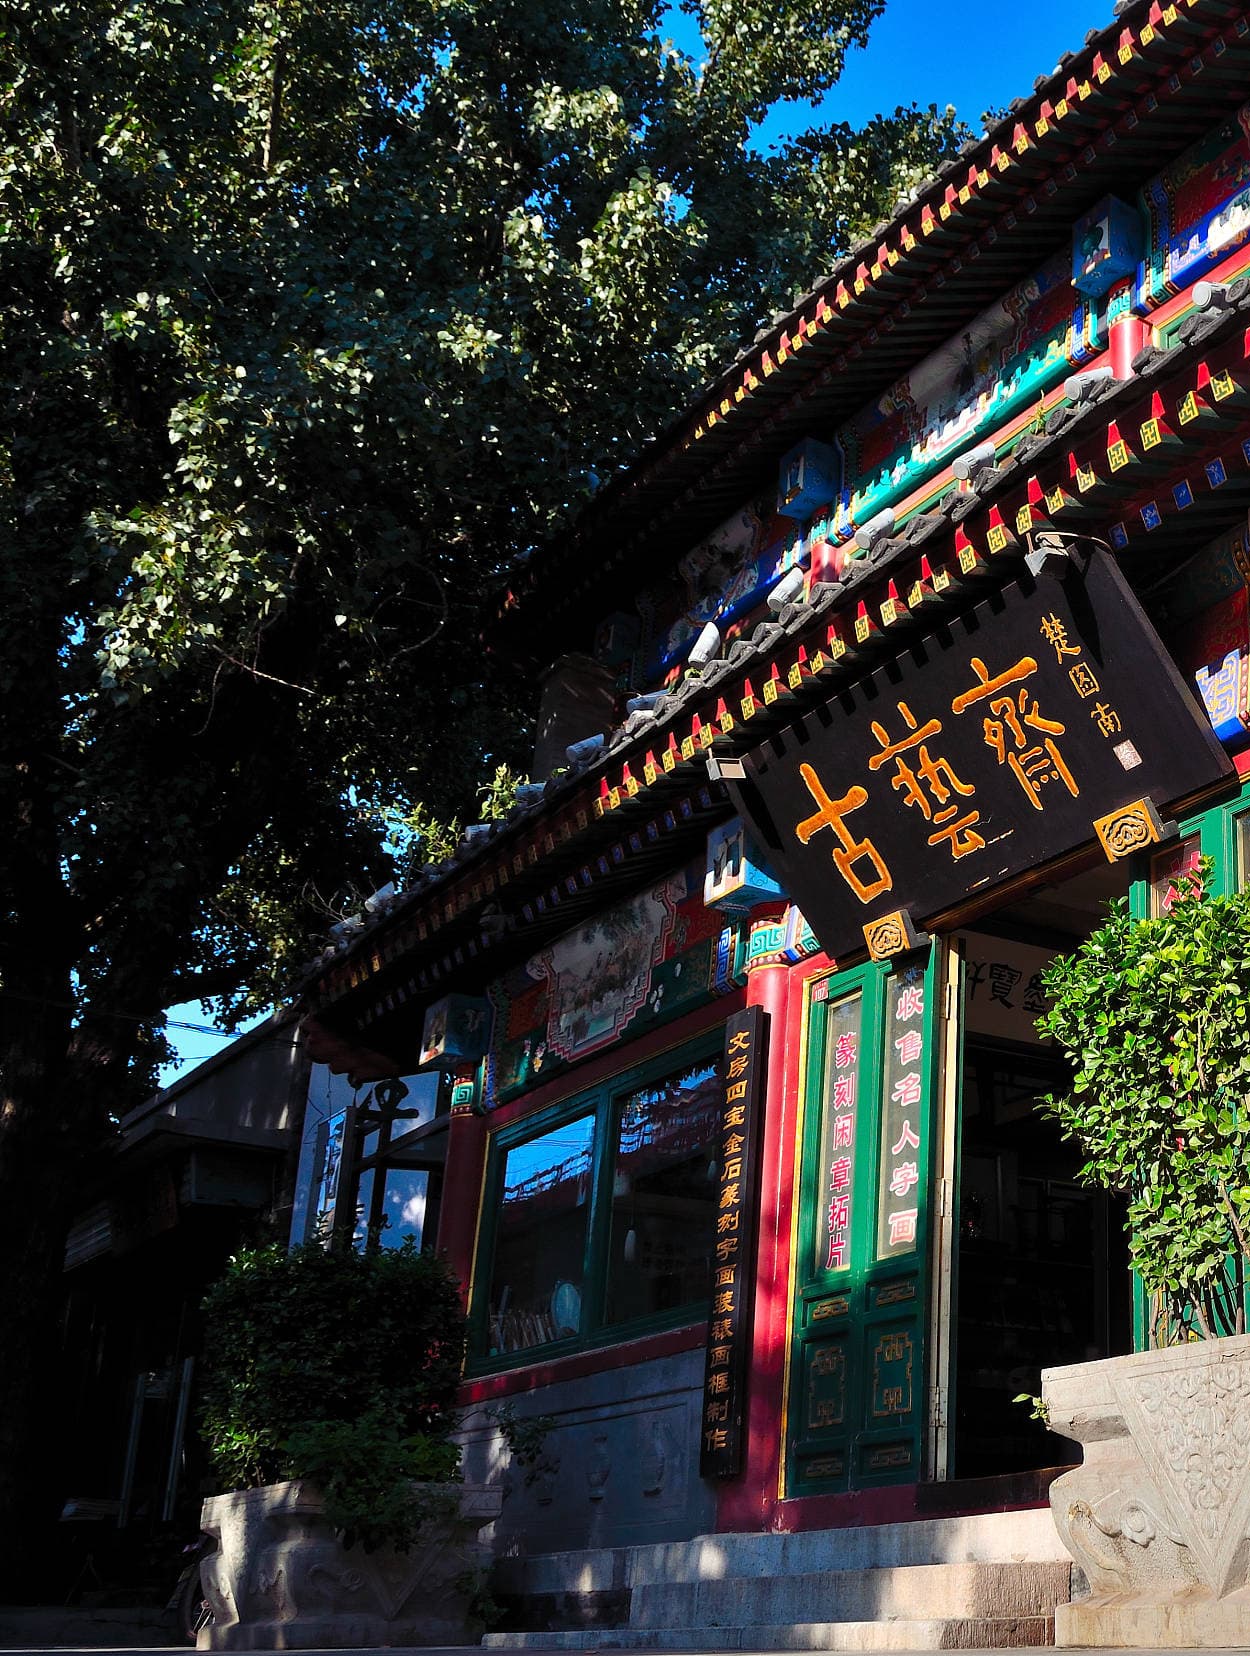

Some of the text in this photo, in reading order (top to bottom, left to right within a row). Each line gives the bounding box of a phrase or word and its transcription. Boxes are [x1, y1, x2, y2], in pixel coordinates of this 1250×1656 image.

[704, 1031, 751, 1452] 文房四宝金石篆刻字画装裱画框制作
[826, 1031, 857, 1269] 篆刻闲章拓片
[889, 986, 924, 1246] 收售名人字画
